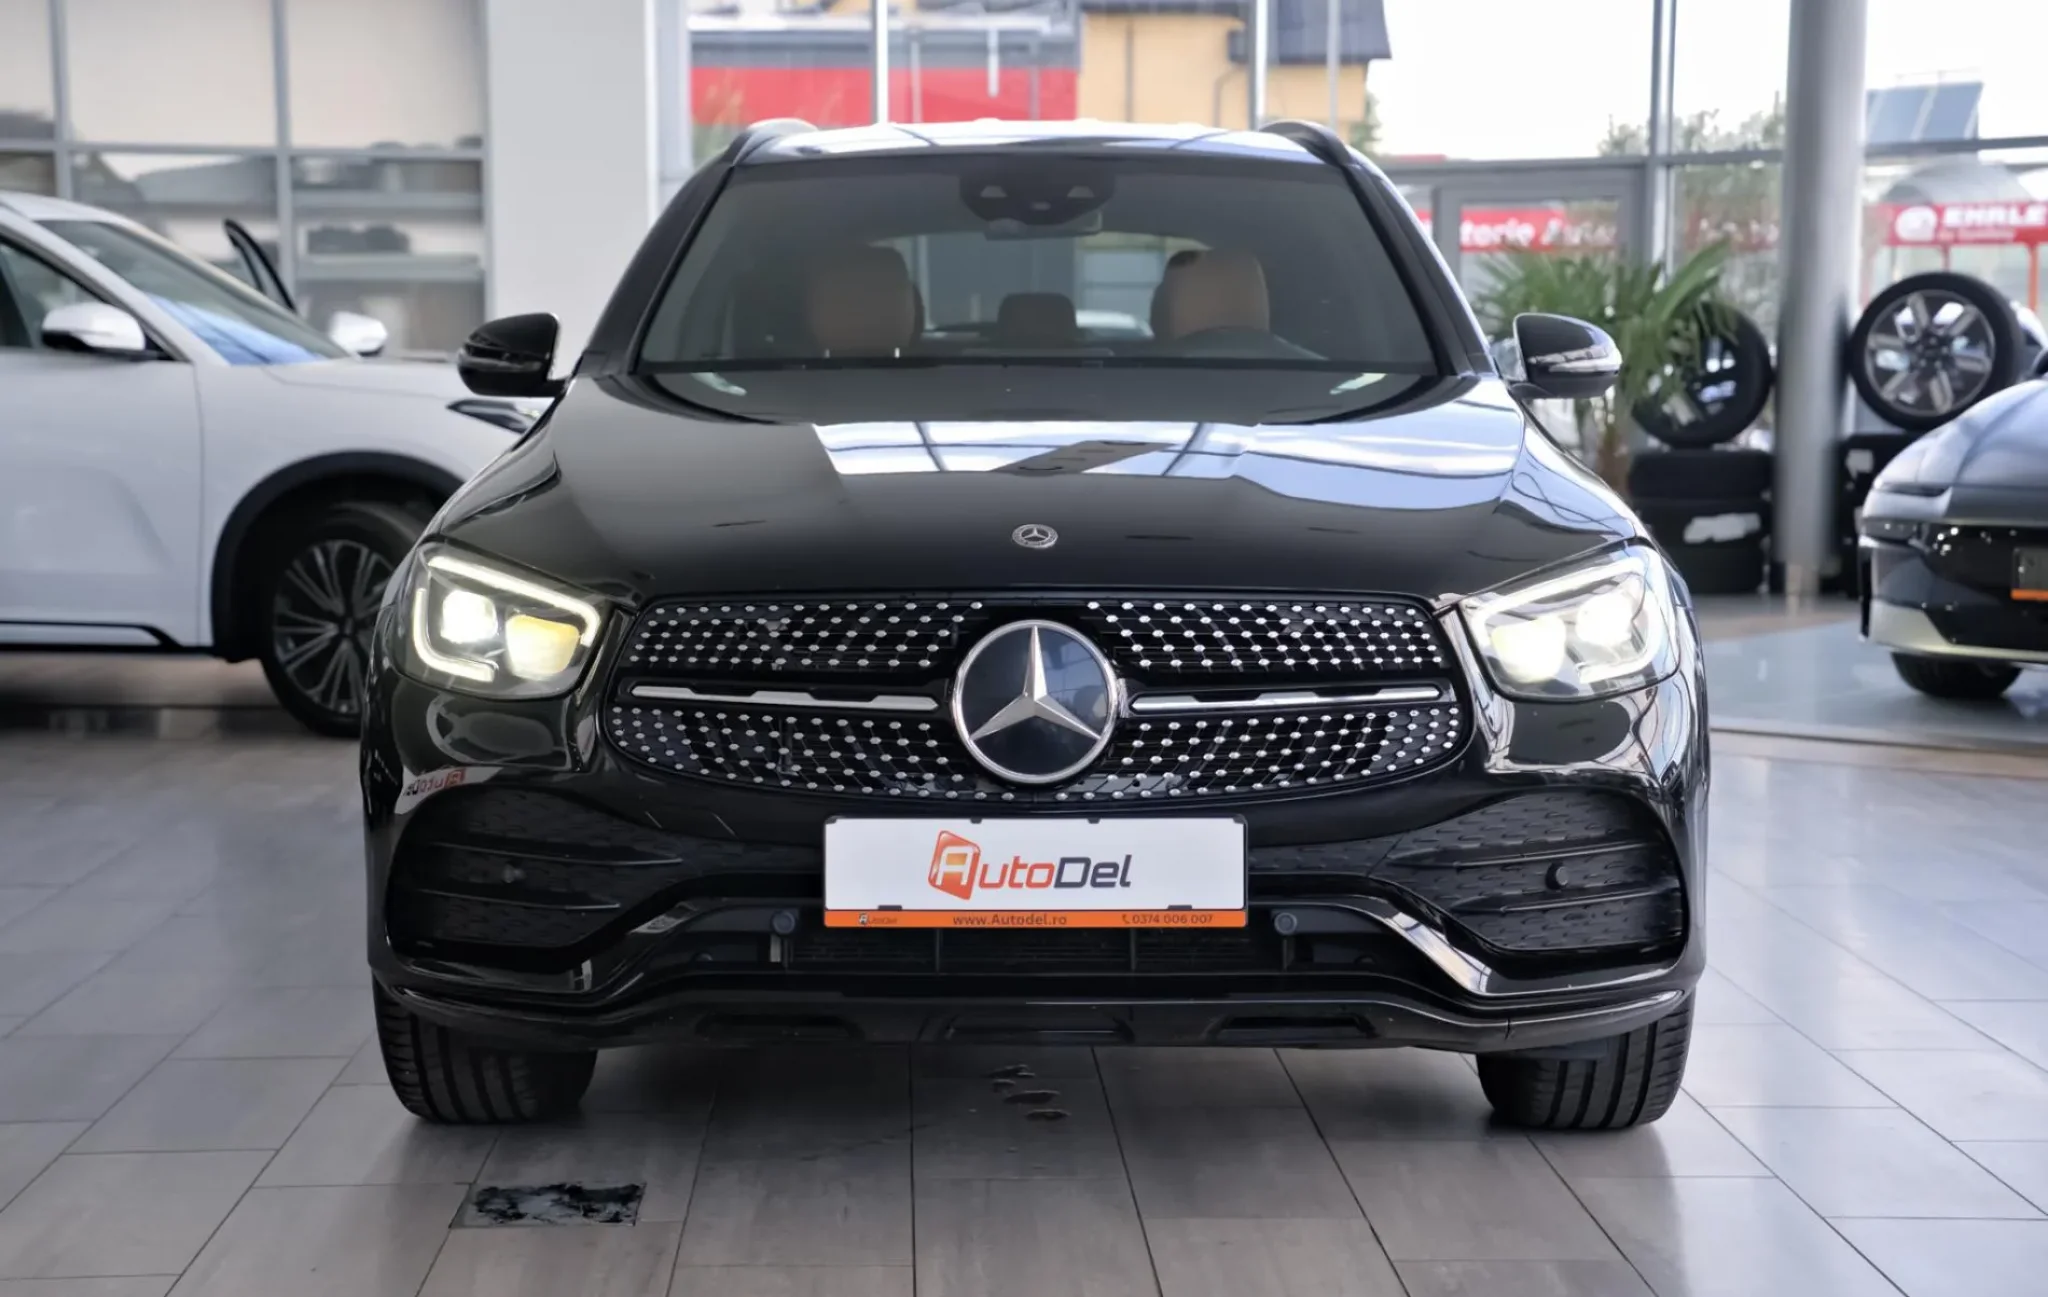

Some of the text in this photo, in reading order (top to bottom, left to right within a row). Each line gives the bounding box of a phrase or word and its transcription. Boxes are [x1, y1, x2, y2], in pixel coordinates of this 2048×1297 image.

[1944, 206, 2047, 227] EHRLE
[929, 831, 1132, 899] AutoDel
[952, 913, 1067, 926] www.Autodel.ro
[1132, 914, 1213, 925] 0374 006 007
